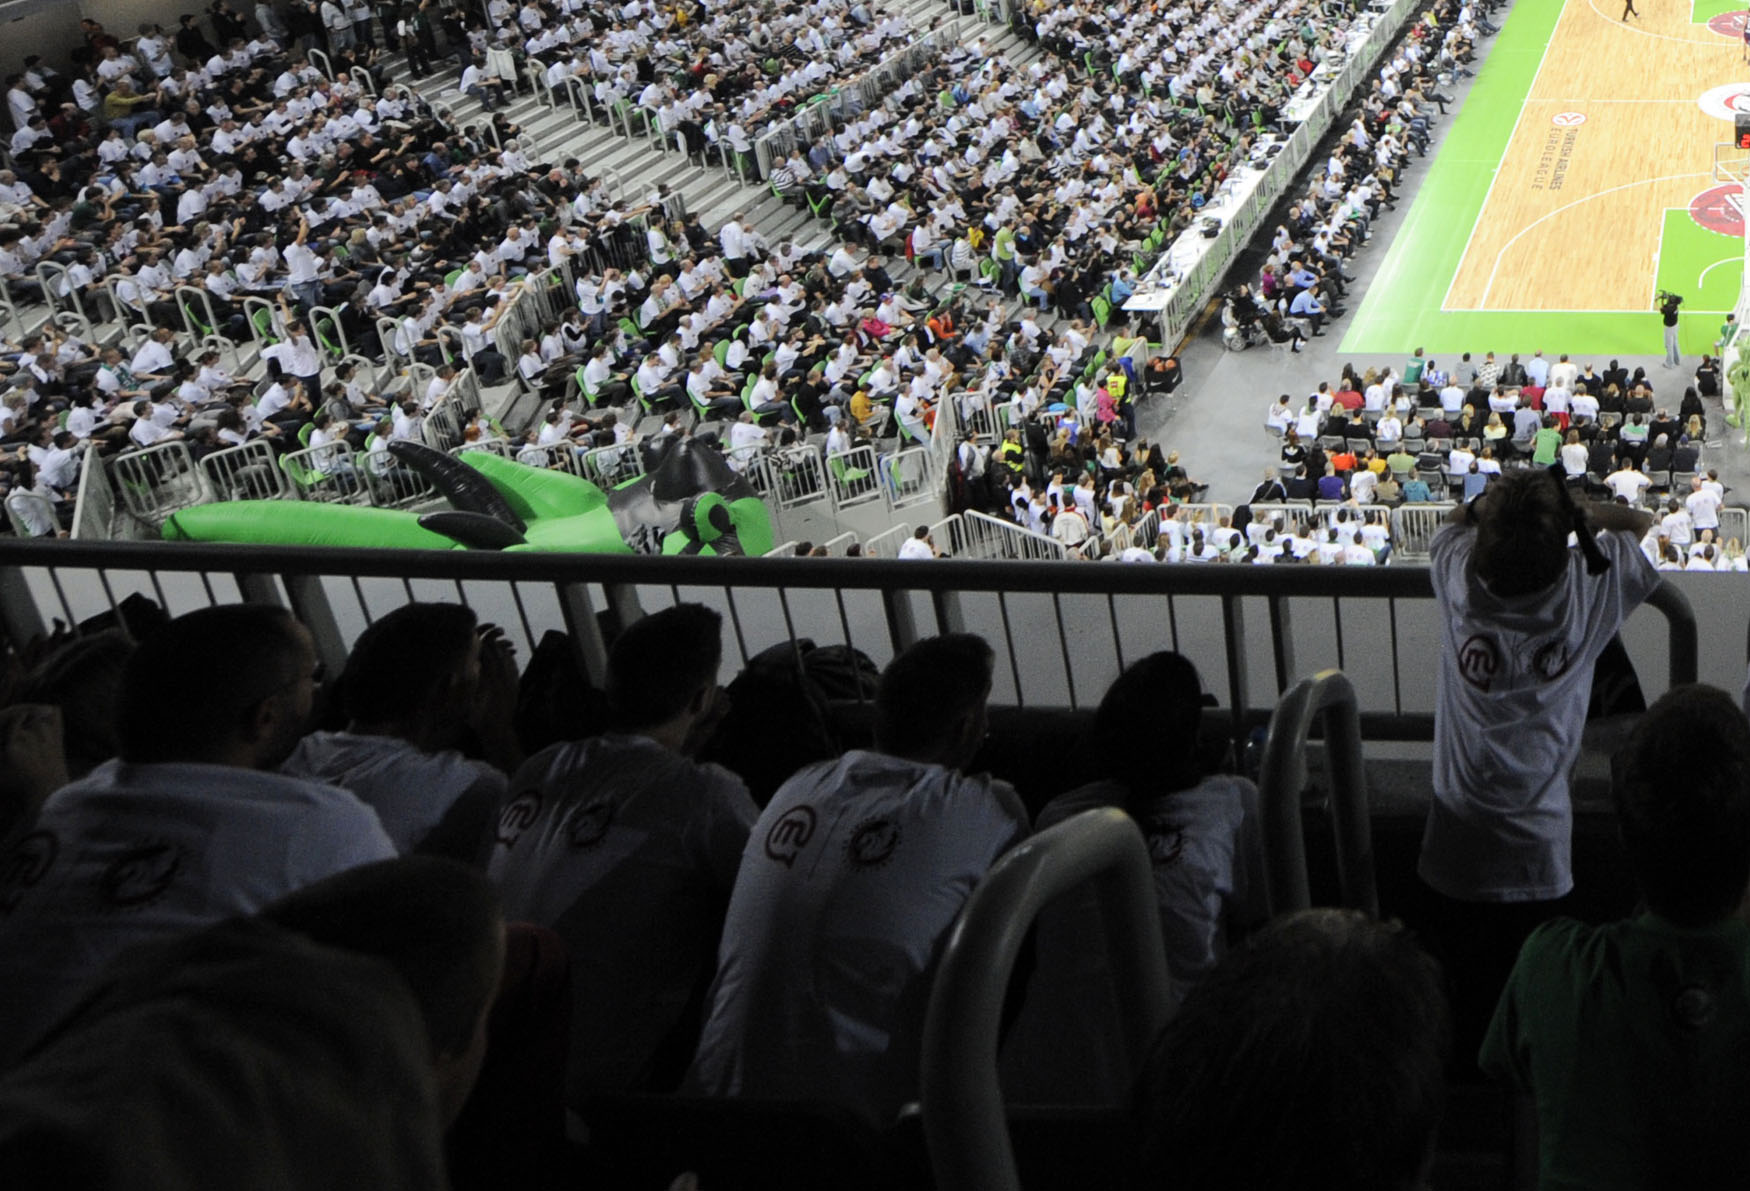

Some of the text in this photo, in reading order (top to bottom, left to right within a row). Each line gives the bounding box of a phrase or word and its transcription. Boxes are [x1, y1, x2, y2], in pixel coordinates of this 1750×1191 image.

[1531, 127, 1563, 190] EUROLEAGUE
[1549, 128, 1579, 190] TURKISH AIRLINES
